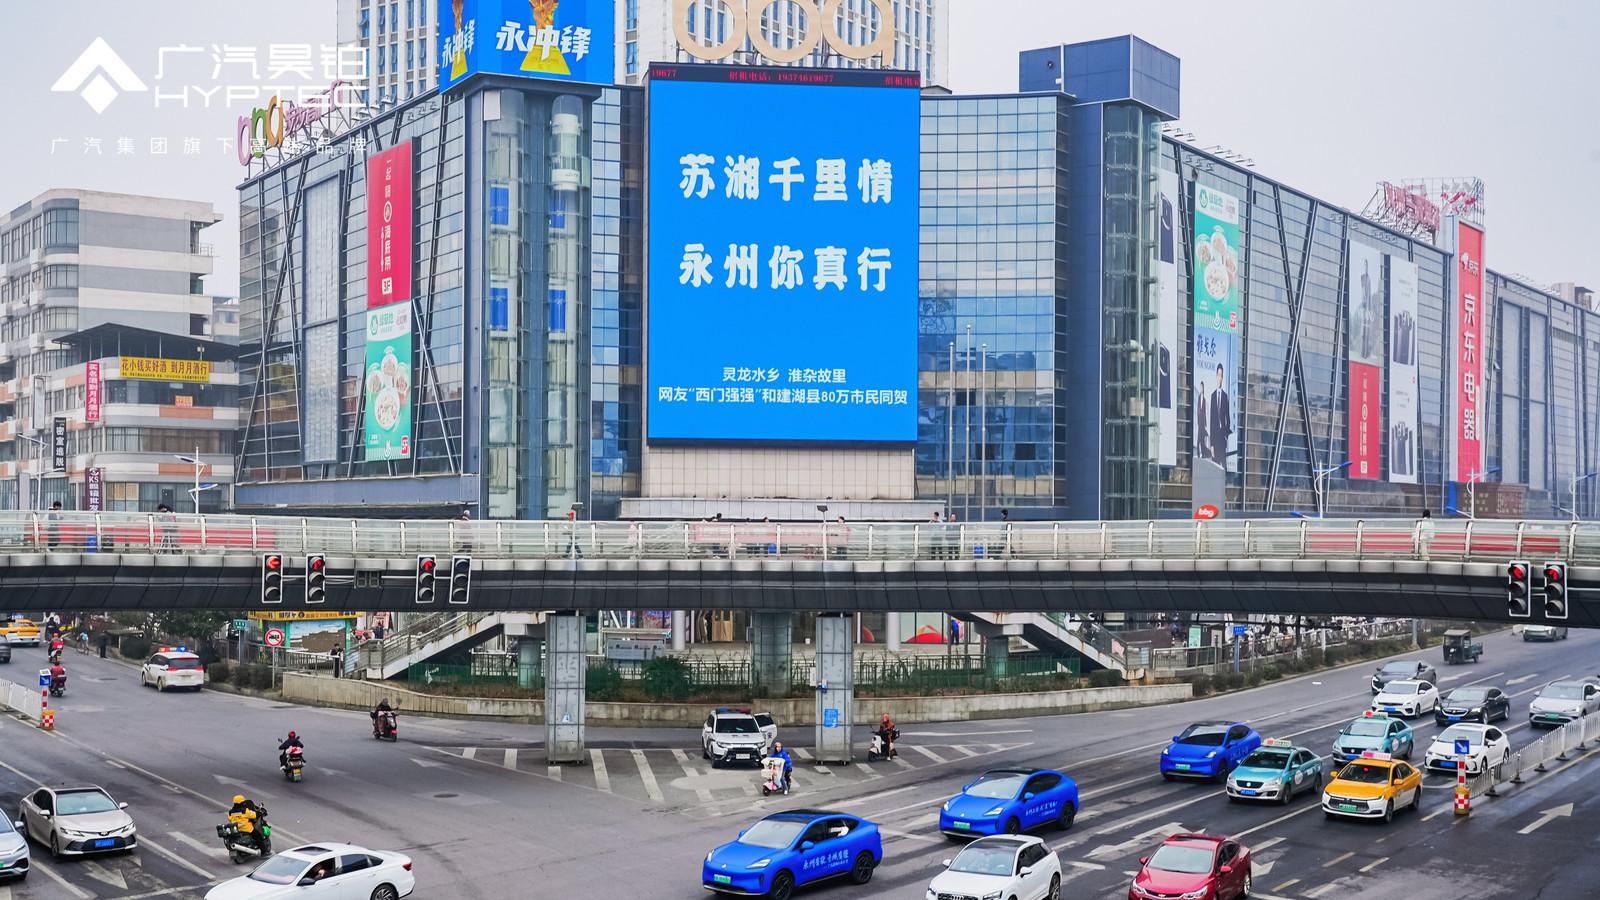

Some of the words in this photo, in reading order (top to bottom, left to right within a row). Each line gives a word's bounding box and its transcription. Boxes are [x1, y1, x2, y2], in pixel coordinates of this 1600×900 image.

[442, 18, 475, 69] 永冲锋
[495, 20, 592, 62] 永冲锋
[679, 153, 894, 205] 苏湘千里情
[679, 243, 893, 292] 永州你真行
[121, 358, 167, 373] 花小钱买好酒
[171, 361, 208, 376] 到月月酒行
[722, 366, 780, 382] 灵龙水乡
[788, 368, 847, 384] 淮杂故里
[1463, 292, 1476, 441] 京东电器
